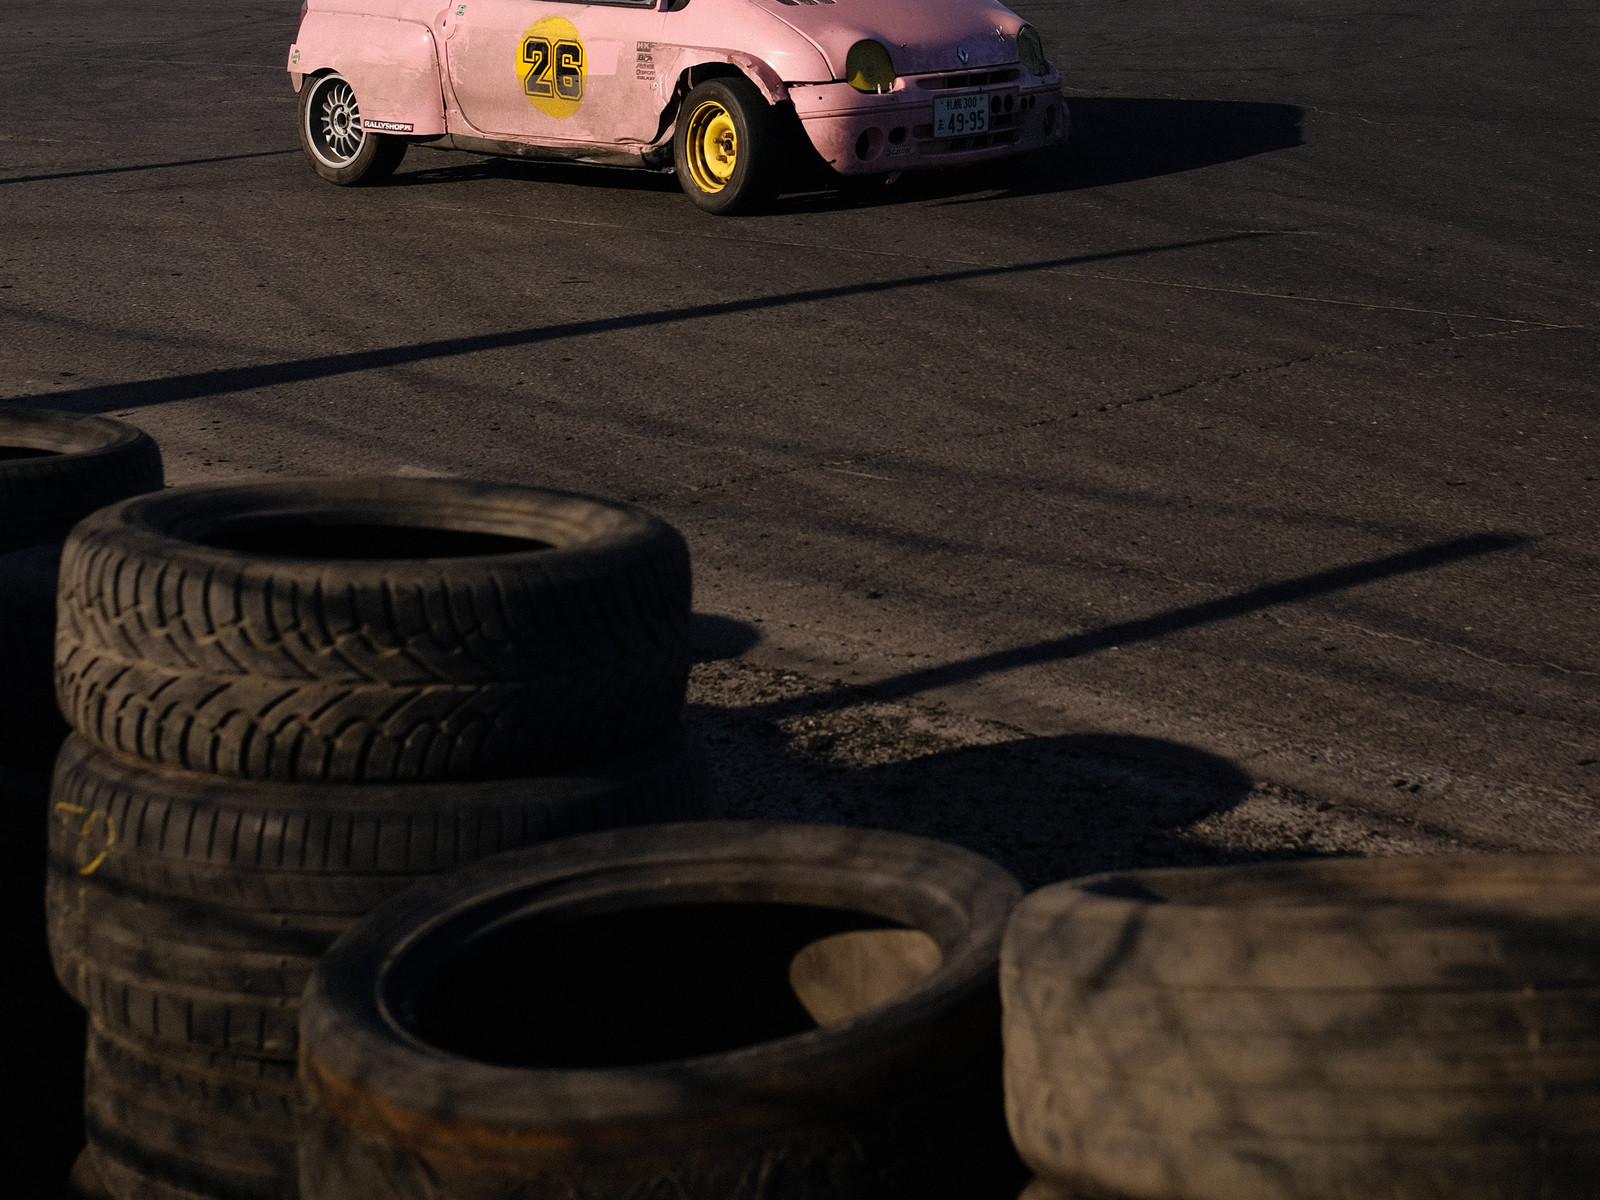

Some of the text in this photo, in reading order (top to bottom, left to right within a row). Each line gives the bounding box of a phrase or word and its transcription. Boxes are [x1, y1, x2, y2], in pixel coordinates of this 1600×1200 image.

[522, 36, 584, 102] 26
[963, 96, 977, 109] 300
[948, 110, 985, 133] 49-95
